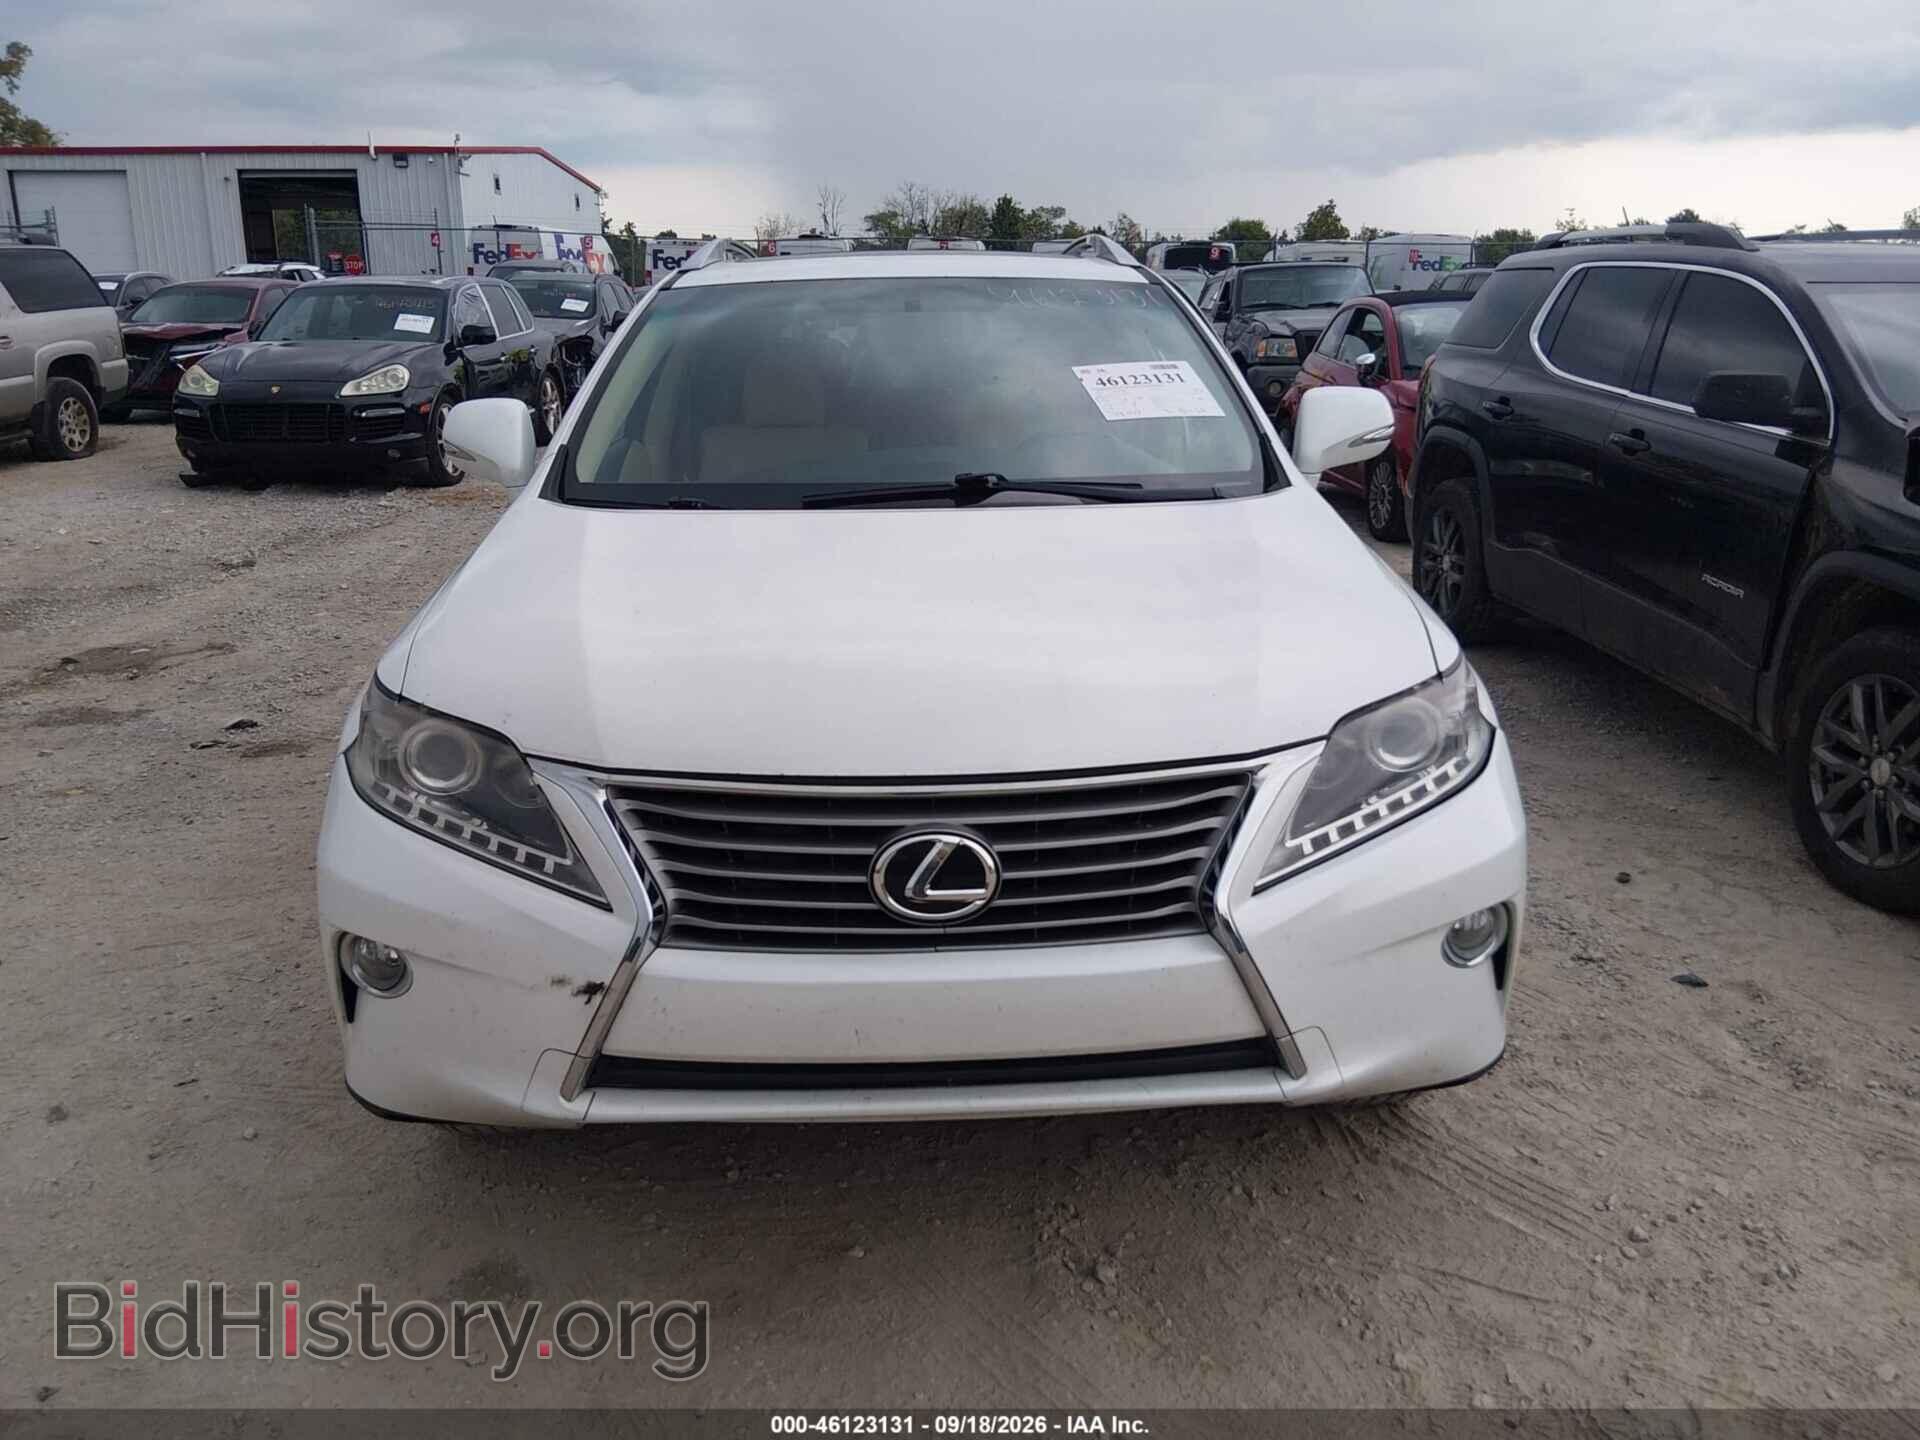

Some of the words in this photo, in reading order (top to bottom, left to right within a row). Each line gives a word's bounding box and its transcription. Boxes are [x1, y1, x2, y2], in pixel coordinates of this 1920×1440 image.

[432, 235, 440, 245] 4
[769, 242, 776, 253] 6
[1211, 247, 1220, 258] 9
[344, 260, 364, 271] STOP
[1095, 372, 1186, 387] 46123131
